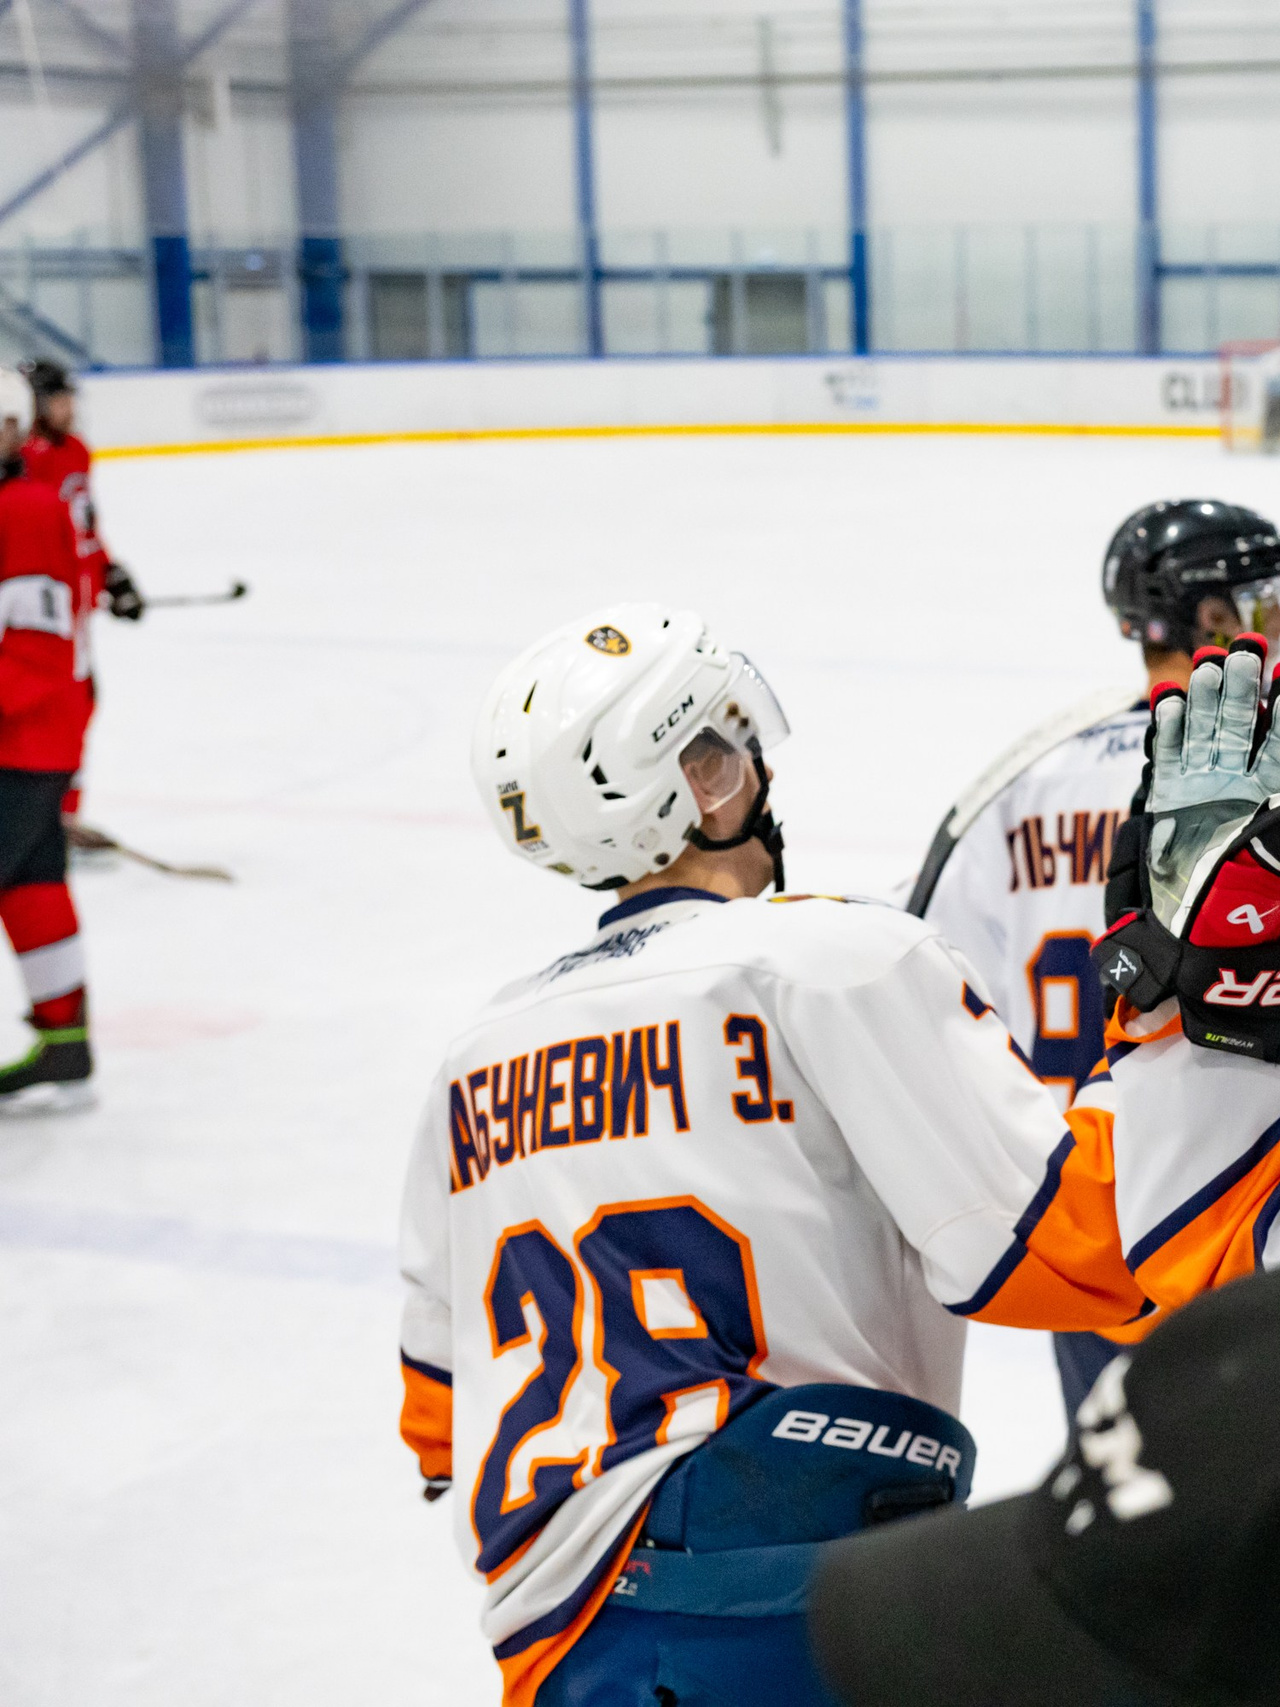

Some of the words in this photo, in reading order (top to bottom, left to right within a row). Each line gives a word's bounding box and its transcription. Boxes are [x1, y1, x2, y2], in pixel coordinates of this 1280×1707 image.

[651, 695, 694, 743] CCM
[499, 791, 543, 844] Z
[450, 1019, 690, 1194] АБУНЕВИЧ
[470, 1195, 785, 1585] 28
